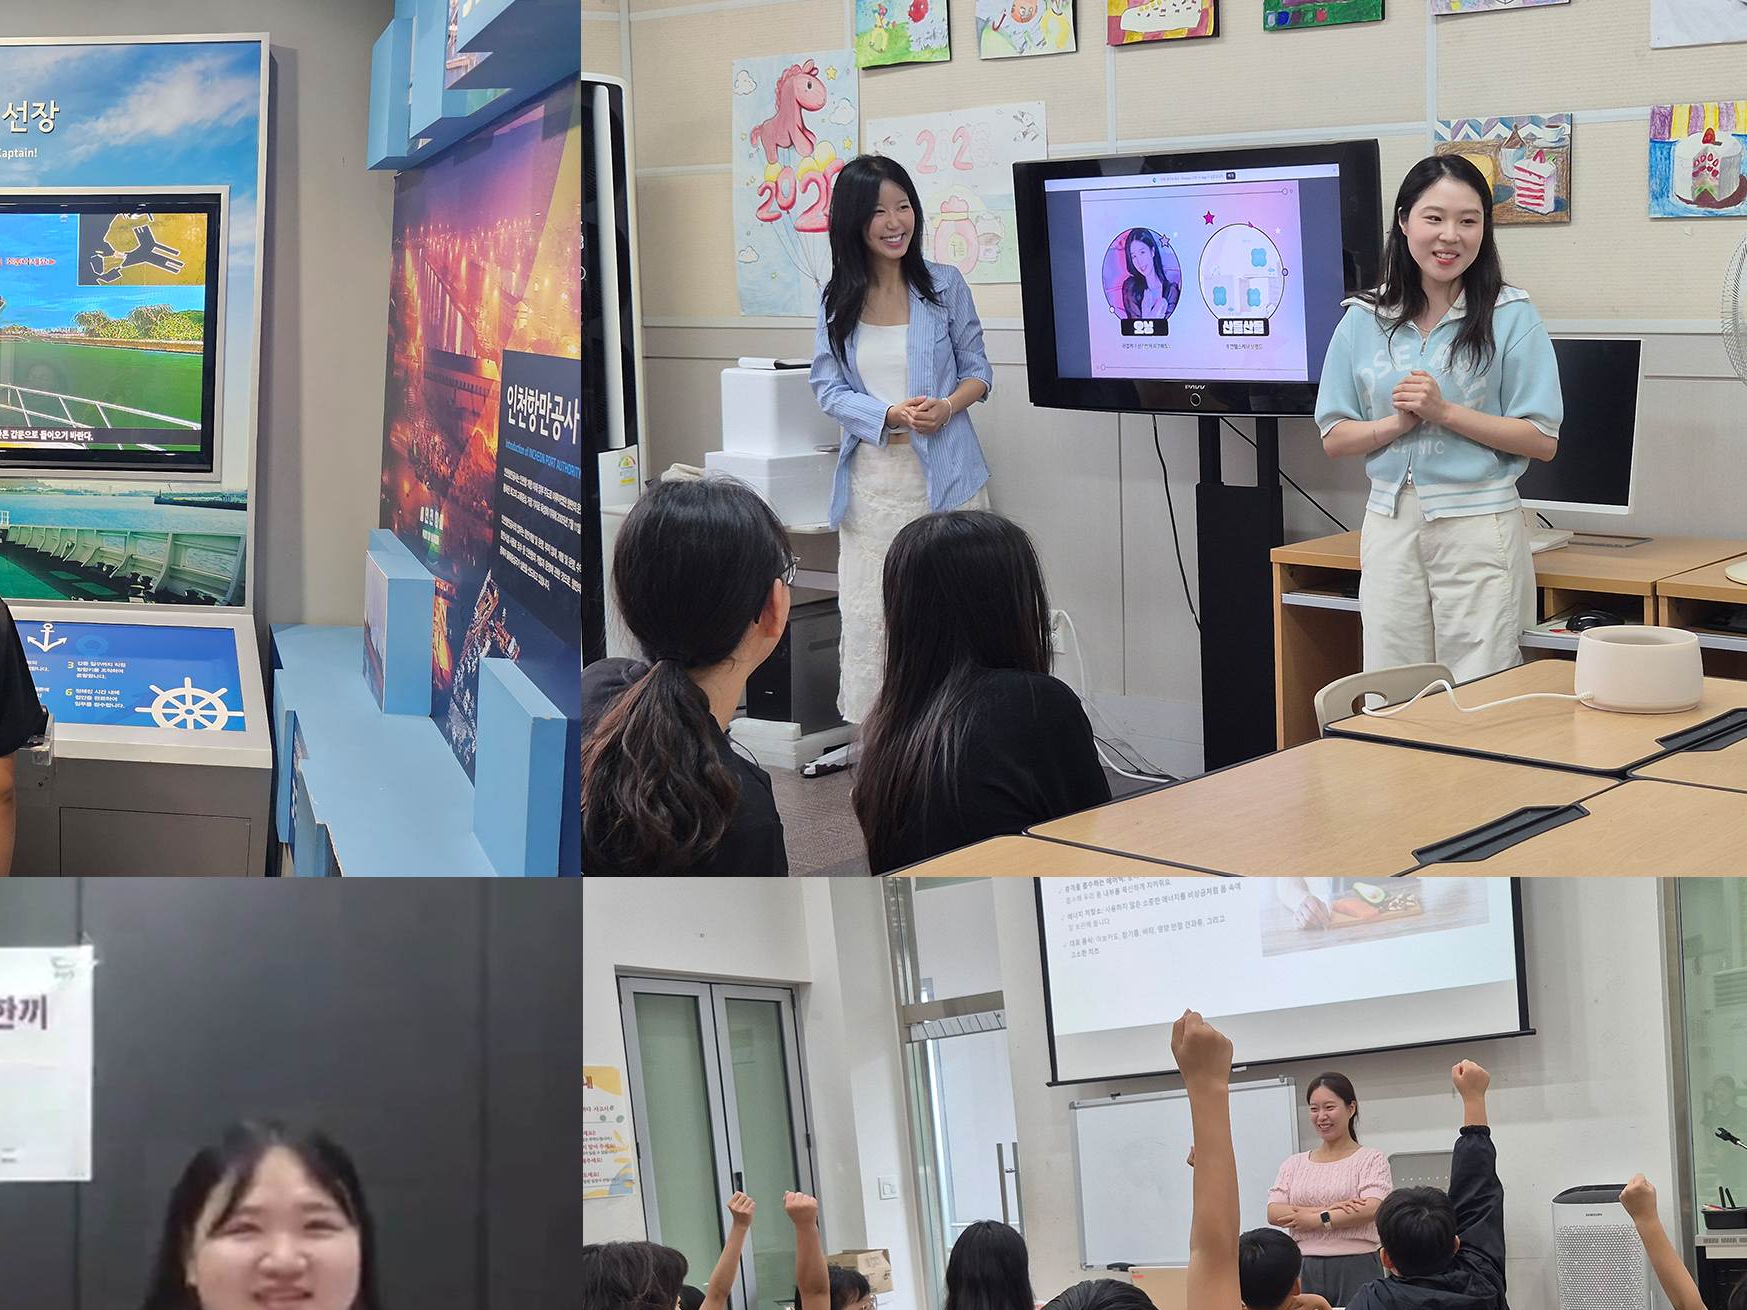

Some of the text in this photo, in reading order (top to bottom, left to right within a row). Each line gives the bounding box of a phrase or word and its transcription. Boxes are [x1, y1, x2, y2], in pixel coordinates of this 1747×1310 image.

[1, 99, 60, 134] 선장
[1222, 320, 1265, 335] 산들산들
[507, 384, 580, 445] 인천항만공사
[40, 430, 68, 440] 들어오기
[69, 430, 94, 441] 바란다.
